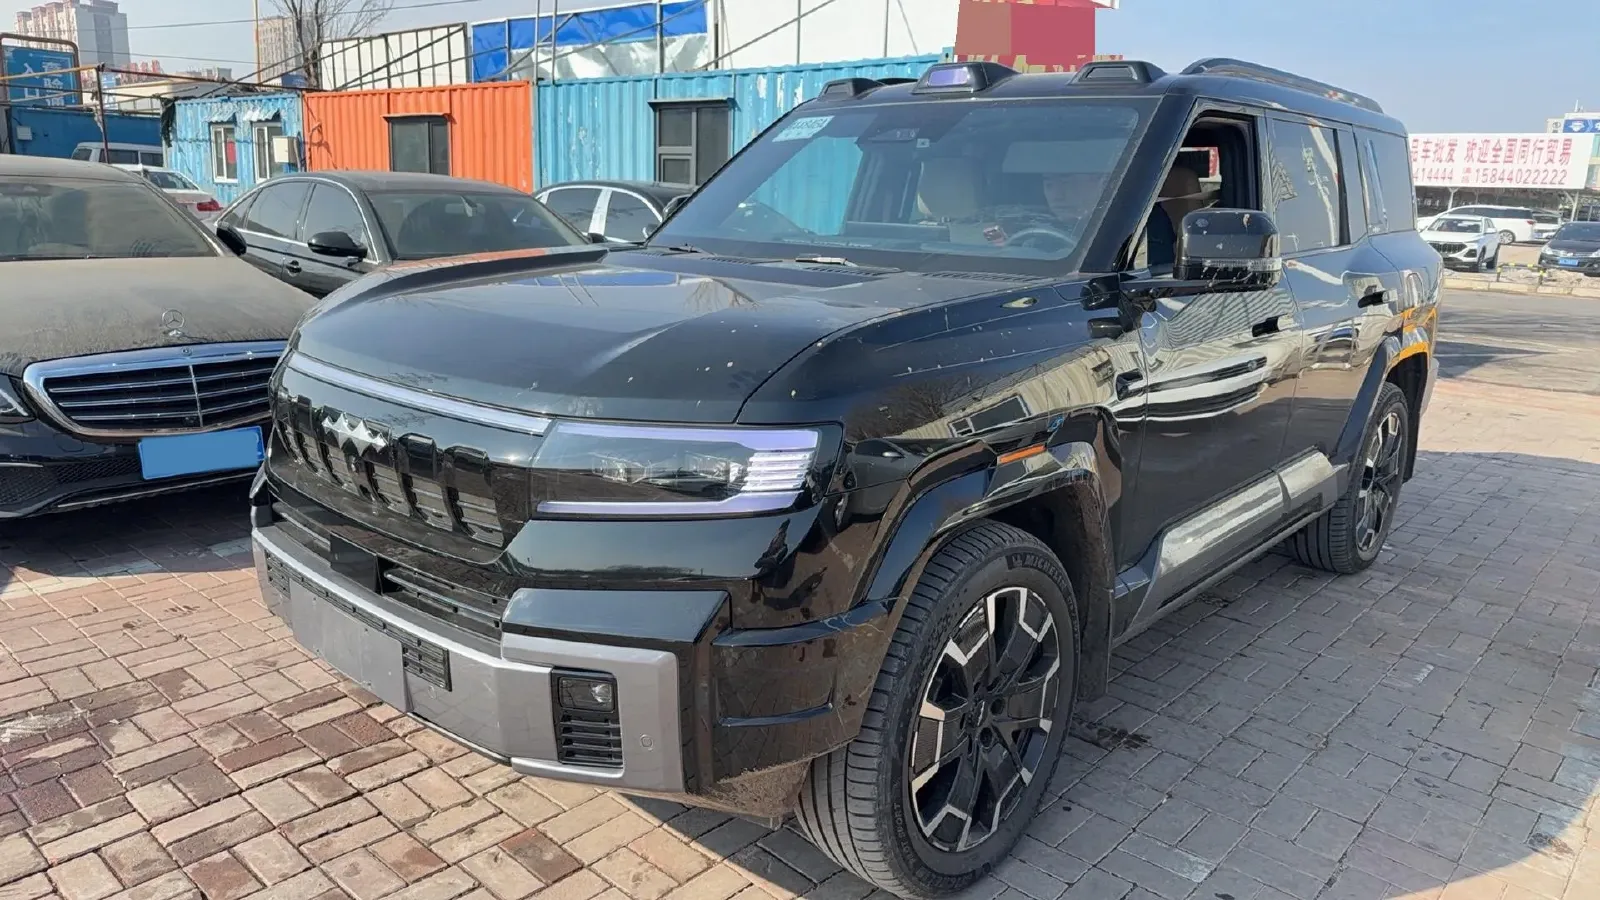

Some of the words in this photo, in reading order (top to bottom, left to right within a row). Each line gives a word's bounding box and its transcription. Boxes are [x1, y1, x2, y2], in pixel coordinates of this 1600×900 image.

[1464, 138, 1573, 166] 欢迎全国同行贸易
[1475, 168, 1568, 185] 15844022222
[1024, 554, 1068, 591] MICHELIN
